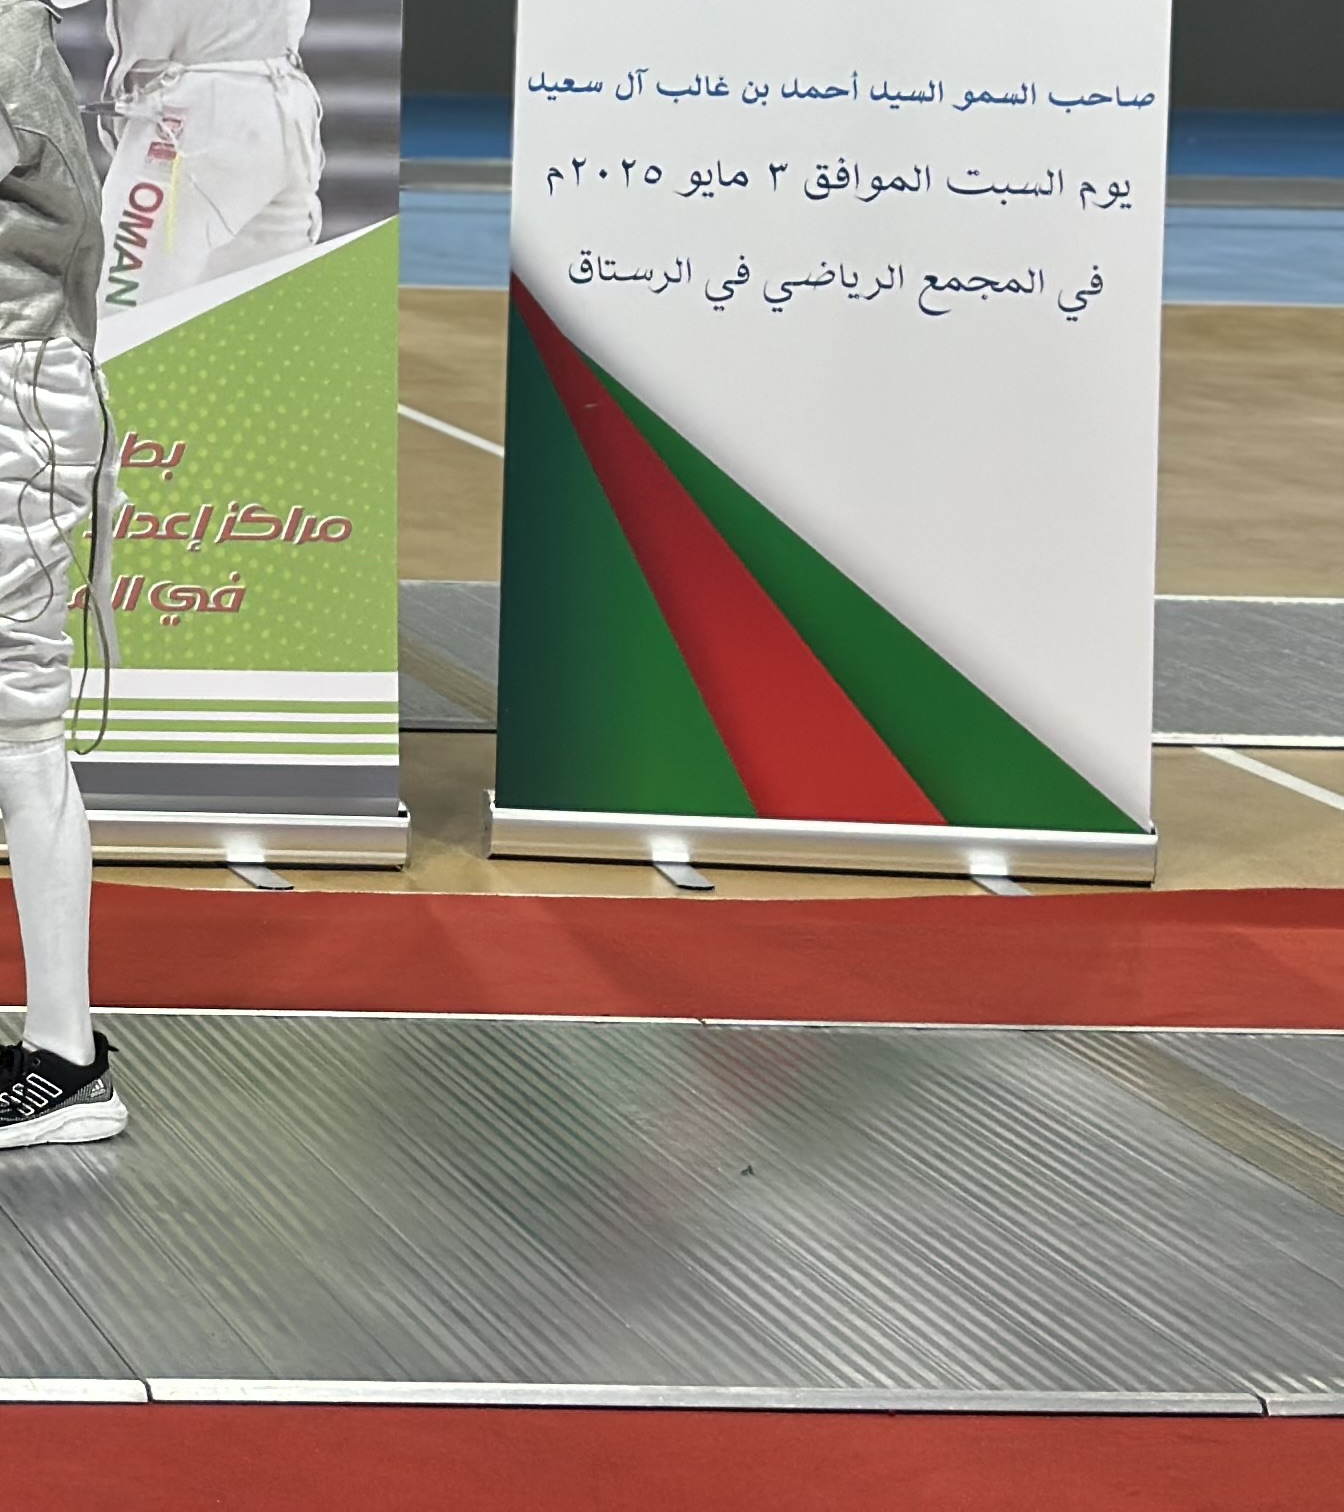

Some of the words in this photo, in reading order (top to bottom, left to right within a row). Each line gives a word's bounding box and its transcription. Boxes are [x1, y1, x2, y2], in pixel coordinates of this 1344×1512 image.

[528, 72, 603, 92] سعيد
[616, 68, 648, 100] آل
[656, 74, 729, 103] غالب
[742, 81, 769, 106] بن
[781, 71, 857, 99] أحمد
[870, 80, 943, 109] السيد
[953, 83, 1036, 111] السمو
[1049, 86, 1155, 113] صاحب
[677, 161, 748, 198] مايو
[769, 163, 788, 190] ٣
[804, 158, 930, 202] الموافق
[947, 170, 1063, 205] السبت
[1080, 180, 1131, 209] يوم
[105, 182, 164, 307] OMAN
[569, 250, 691, 292] الرستاق
[705, 255, 750, 311] في
[764, 262, 903, 312] الرياضي
[919, 269, 1044, 316] المجمع
[1058, 265, 1103, 322] في
[84, 502, 215, 554] إعدا
[215, 498, 354, 546] مراكز
[147, 570, 248, 628] في
